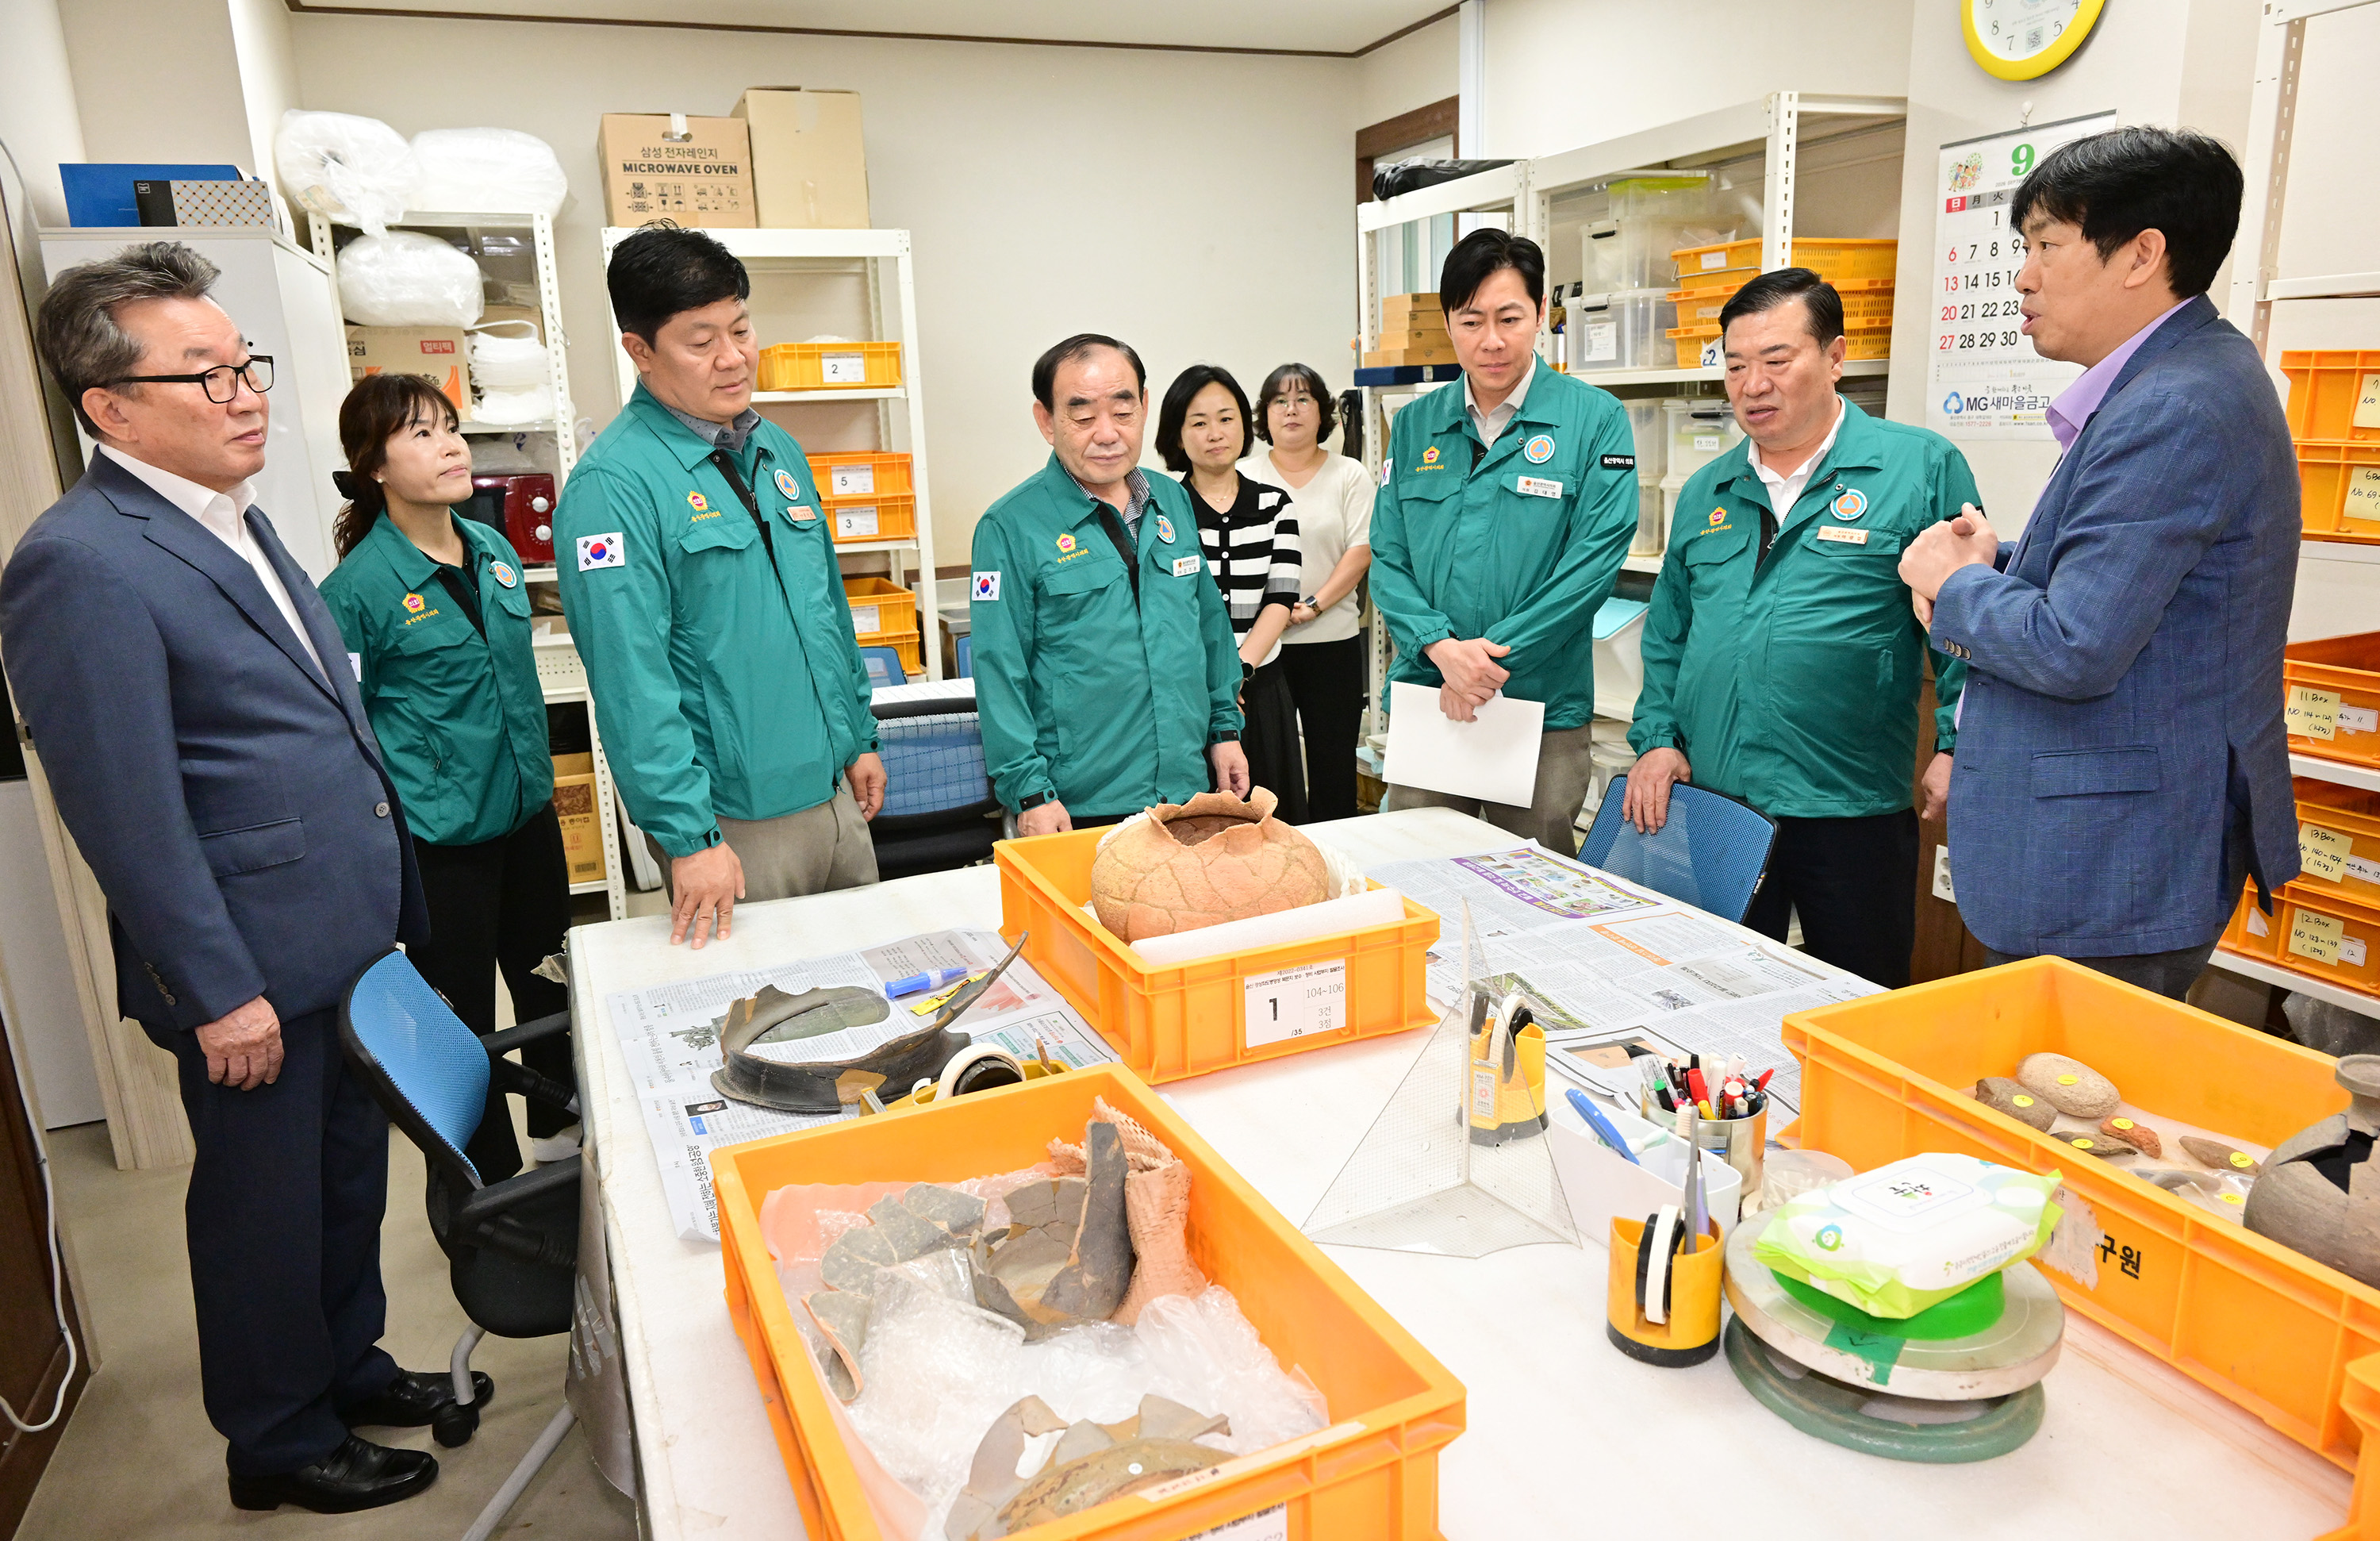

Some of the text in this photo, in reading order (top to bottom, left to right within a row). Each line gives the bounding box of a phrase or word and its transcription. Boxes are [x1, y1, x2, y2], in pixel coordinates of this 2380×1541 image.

[1991, 20, 1999, 36] 8
[2053, 21, 2063, 37] 5
[2006, 35, 2014, 51] 7
[640, 147, 718, 159] 삼성 전자레인지
[2011, 144, 2035, 176] 9
[622, 162, 739, 175] MICROWAVE OVEN
[1952, 191, 2003, 208] 日 月 火
[1994, 211, 1999, 226] 1
[1948, 239, 2021, 262] 6 7 8 9
[1944, 276, 1959, 291] 13
[1964, 274, 1979, 290] 14
[1985, 271, 2000, 287] 15
[1941, 300, 2019, 321] 20 21 22 23
[423, 341, 452, 353] 멀티팩
[1940, 331, 2017, 350] 27 28 29 30
[831, 364, 839, 374] 2
[1966, 396, 2050, 411] MG 새마을금고
[1603, 456, 1633, 466] 울산광역시 의회
[841, 477, 848, 486] 5
[2367, 490, 2378, 499] 69
[846, 518, 852, 528] 3
[2301, 691, 2328, 703] 11 Box
[2311, 829, 2336, 843] 13 Box
[2301, 913, 2330, 928] 12 Box
[1277, 964, 1314, 976] 제2022-0341호
[1307, 983, 1344, 999] 104~106
[1269, 997, 1278, 1021] 1
[1319, 1006, 1331, 1016] 3건
[1319, 1018, 1331, 1029] 3점
[1291, 1028, 1303, 1037] /35
[693, 1166, 709, 1182] 소중한
[2095, 1234, 2141, 1280] 구원
